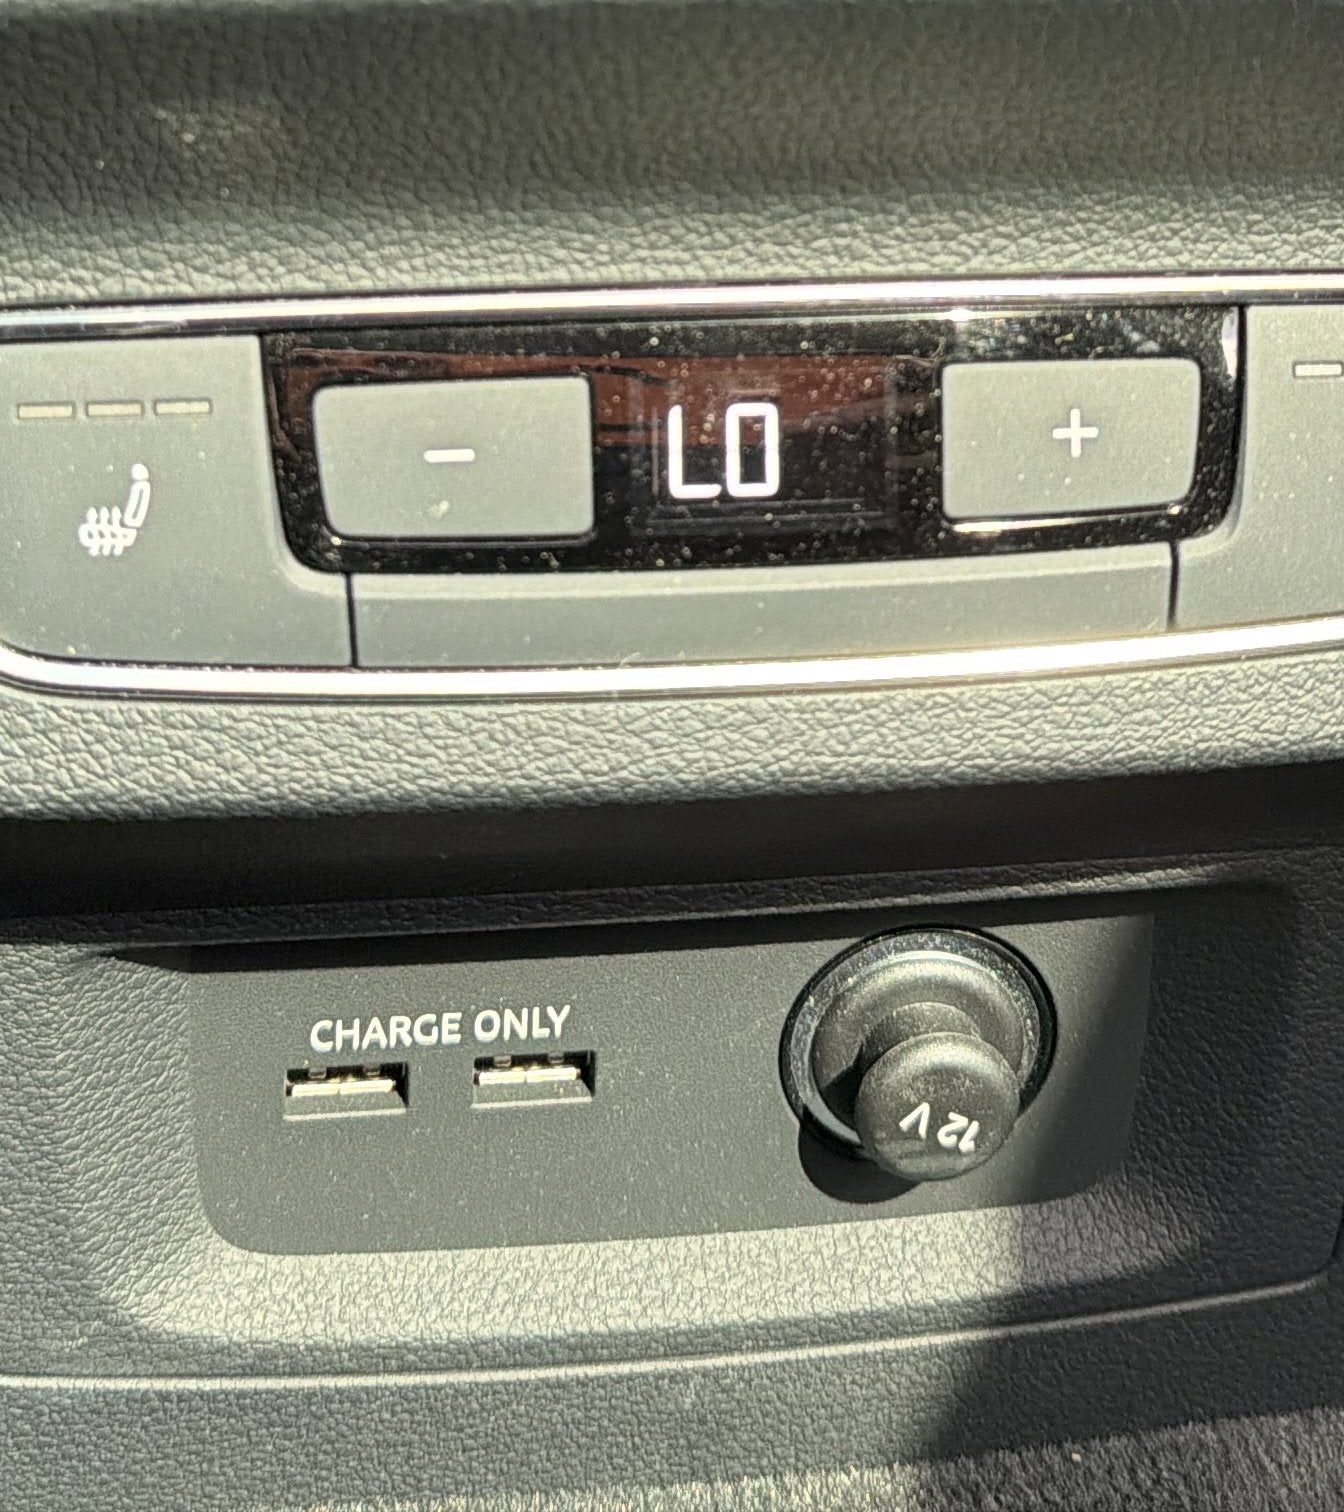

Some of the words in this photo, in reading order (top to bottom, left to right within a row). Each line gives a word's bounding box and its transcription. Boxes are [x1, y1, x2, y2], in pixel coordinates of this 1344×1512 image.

[667, 402, 780, 499] LO
[309, 1012, 463, 1053] CHARGE
[473, 1004, 572, 1043] ONLY
